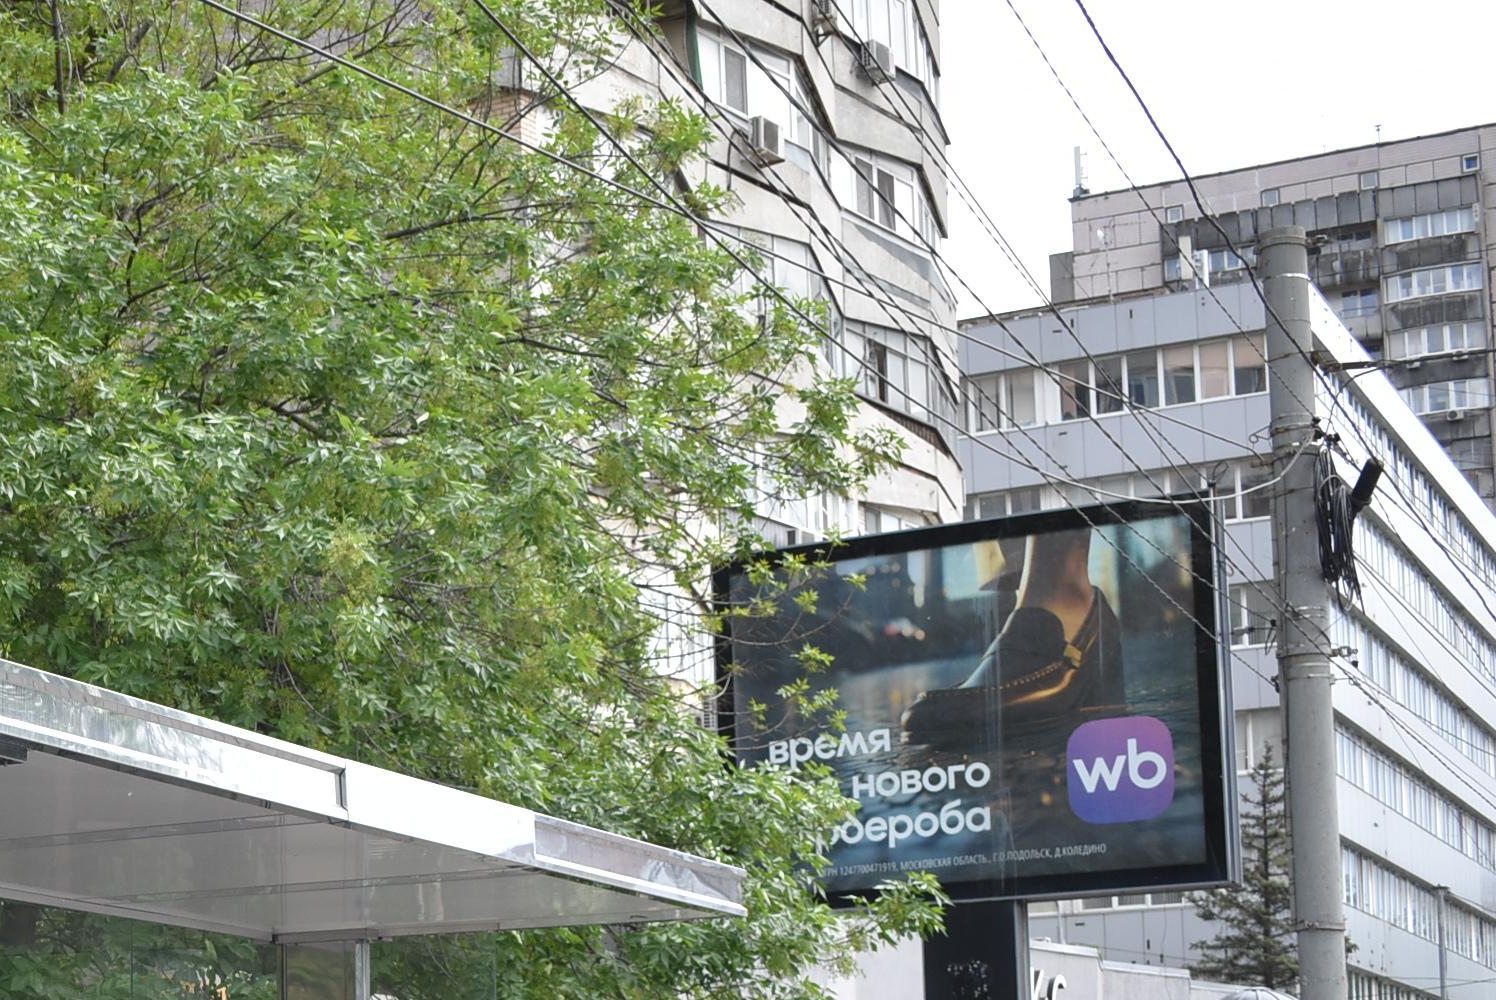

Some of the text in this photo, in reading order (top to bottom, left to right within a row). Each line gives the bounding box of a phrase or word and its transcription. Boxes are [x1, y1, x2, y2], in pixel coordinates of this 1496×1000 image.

[768, 728, 891, 770] время
[1073, 738, 1167, 793] wb
[852, 761, 991, 799] нового
[900, 858, 951, 870] МОСКОВСКАЯ
